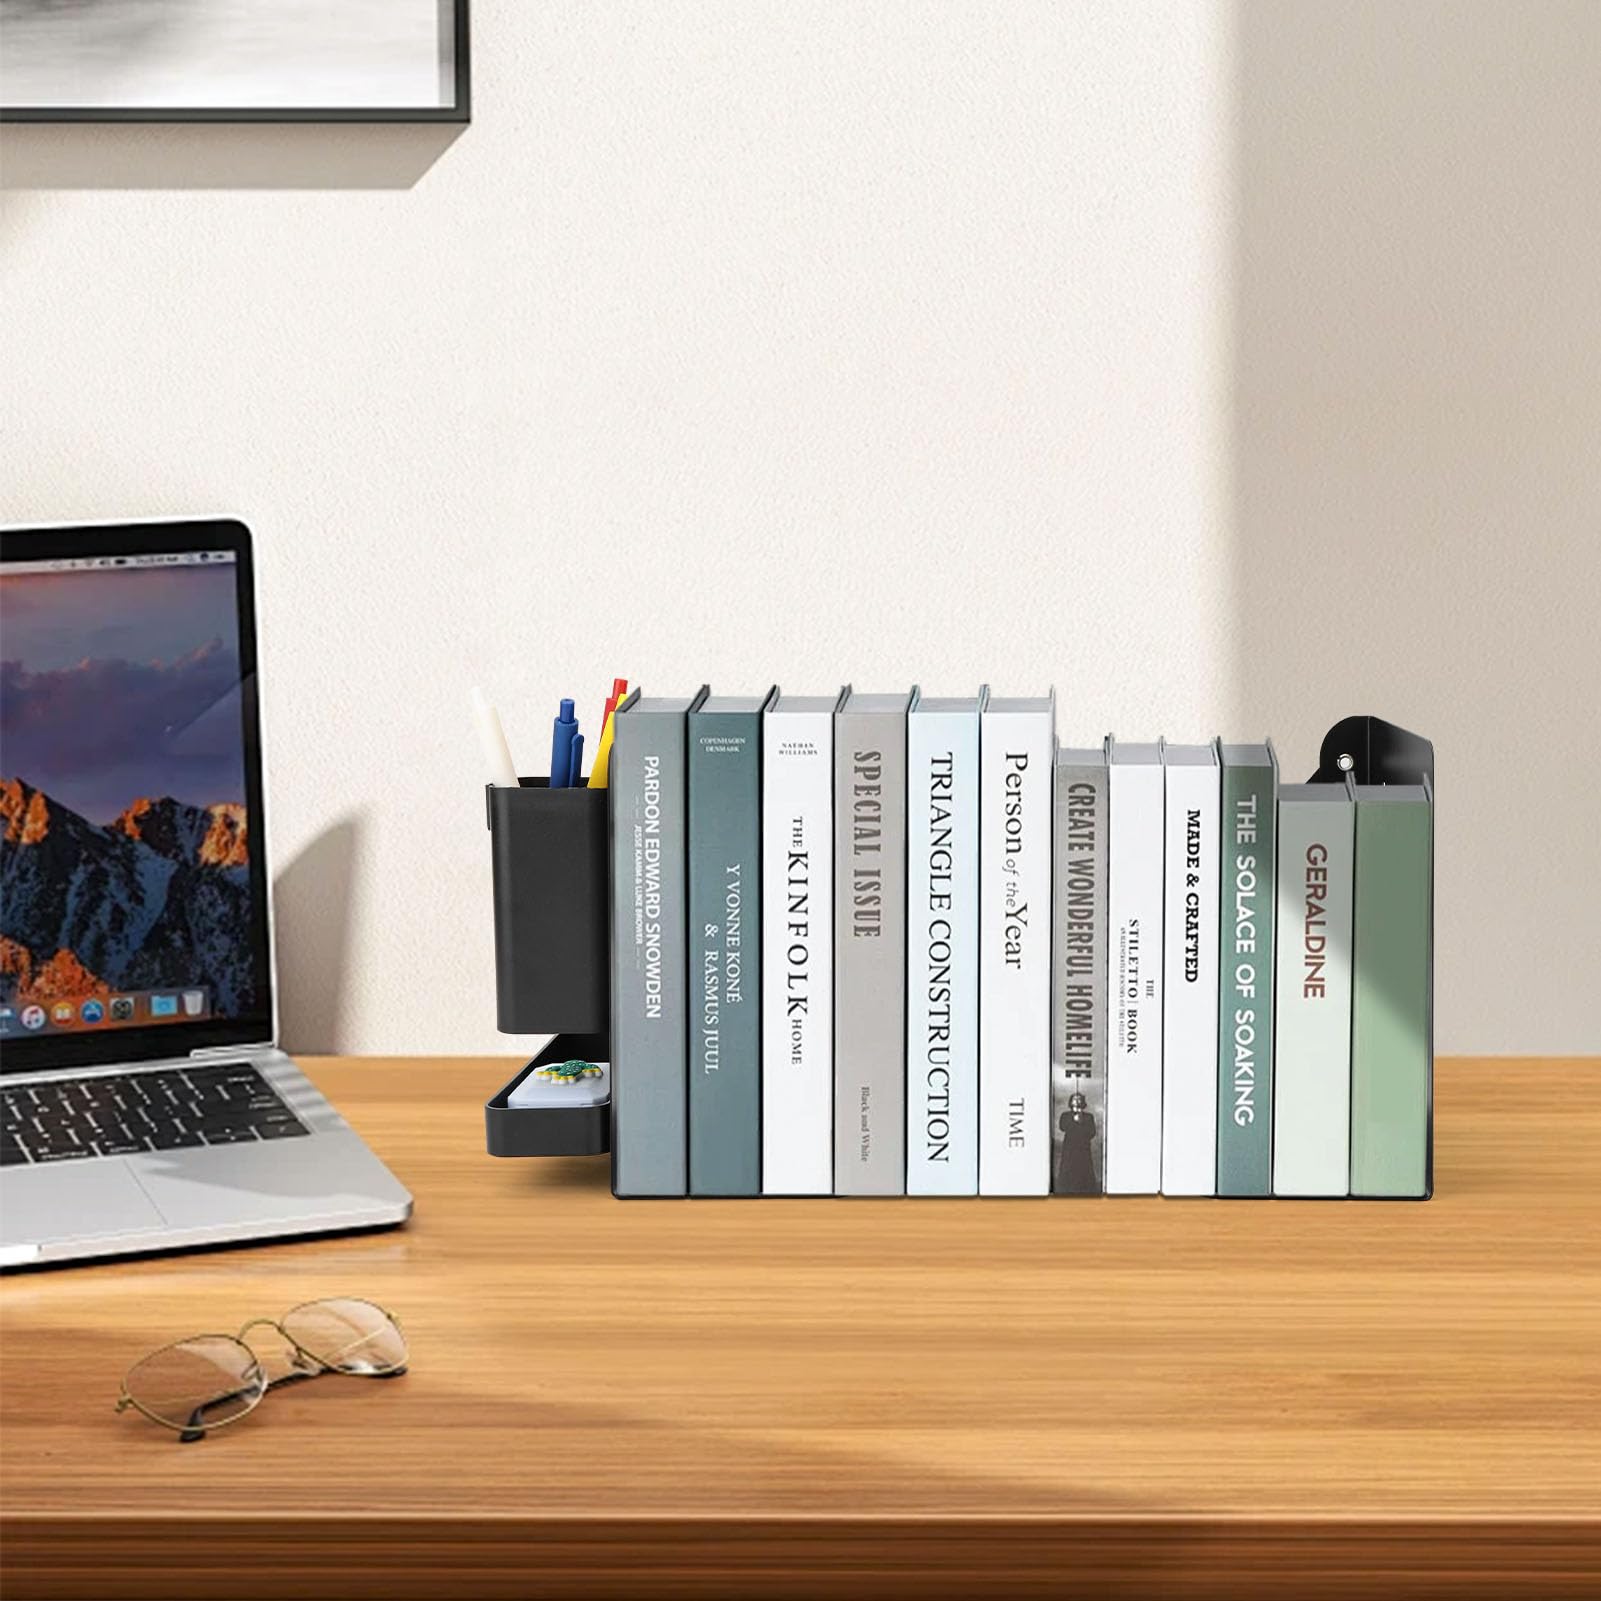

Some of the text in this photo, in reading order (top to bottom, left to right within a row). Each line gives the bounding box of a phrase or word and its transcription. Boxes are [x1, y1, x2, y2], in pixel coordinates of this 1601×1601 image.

[699, 737, 746, 745] COPENHAGEN
[705, 745, 741, 753] DENMARK
[633, 886, 643, 907] LUKE
[644, 756, 662, 1018] PARDON EDWARD SNOWDEN
[853, 751, 882, 938] SPECIAL ISSUE
[1002, 752, 1029, 970] Person of the Year
[1184, 809, 1201, 983] MADE & CRAFTED
[633, 908, 643, 944] BROWER
[725, 951, 743, 1004] KONÉ
[787, 816, 809, 1065] THE KINFOLK HOME
[927, 752, 954, 1163] TRIANGLE CONSTRUCTION
[1065, 783, 1097, 1079] CREATE WONDERFUL HOMELIFE
[1126, 919, 1140, 1054] STILETTO BOOK
[1234, 794, 1257, 1127] THE SOLACE OF SOAKING
[1304, 843, 1328, 1000] GERALDINE
[702, 924, 720, 1074] & RASMUS JUUL
[859, 1087, 870, 1162] Black and White
[1008, 1097, 1025, 1148] TIME
